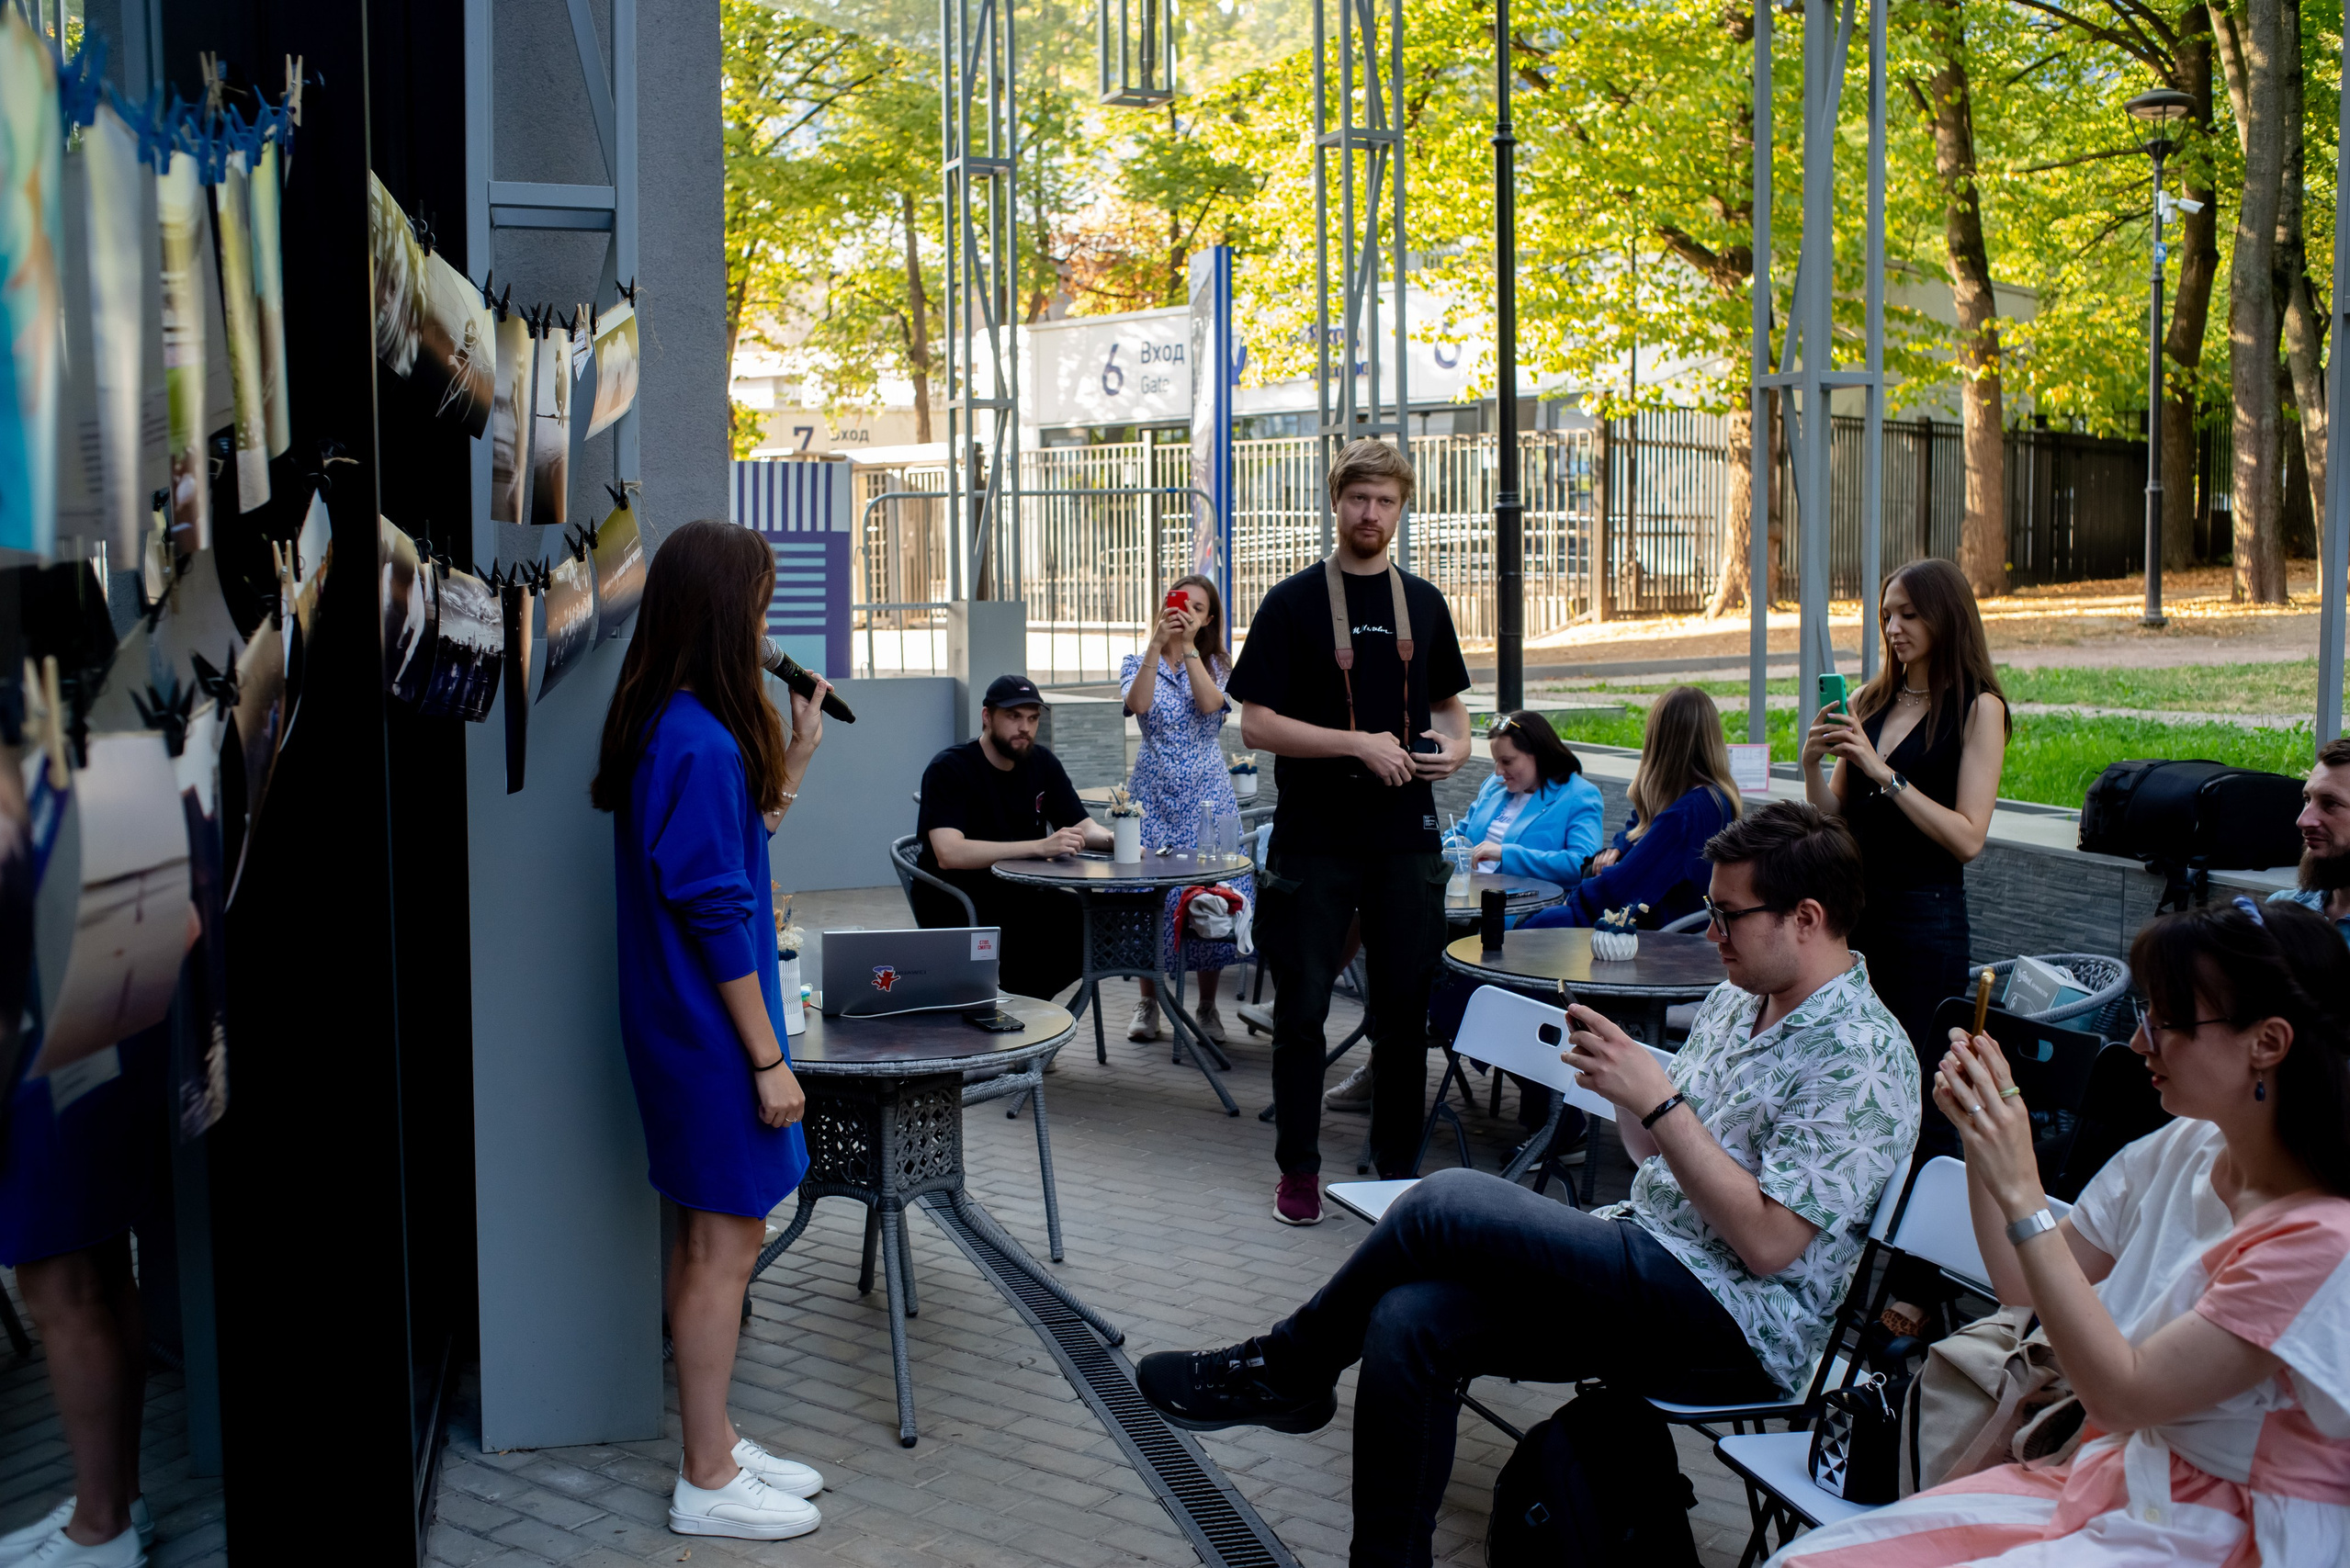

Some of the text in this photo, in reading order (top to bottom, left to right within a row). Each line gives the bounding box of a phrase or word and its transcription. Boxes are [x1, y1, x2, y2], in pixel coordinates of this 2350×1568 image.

[1102, 343, 1124, 397] 6
[1141, 341, 1185, 366] Вход
[1140, 375, 1170, 395] Gate
[793, 426, 815, 450] 7
